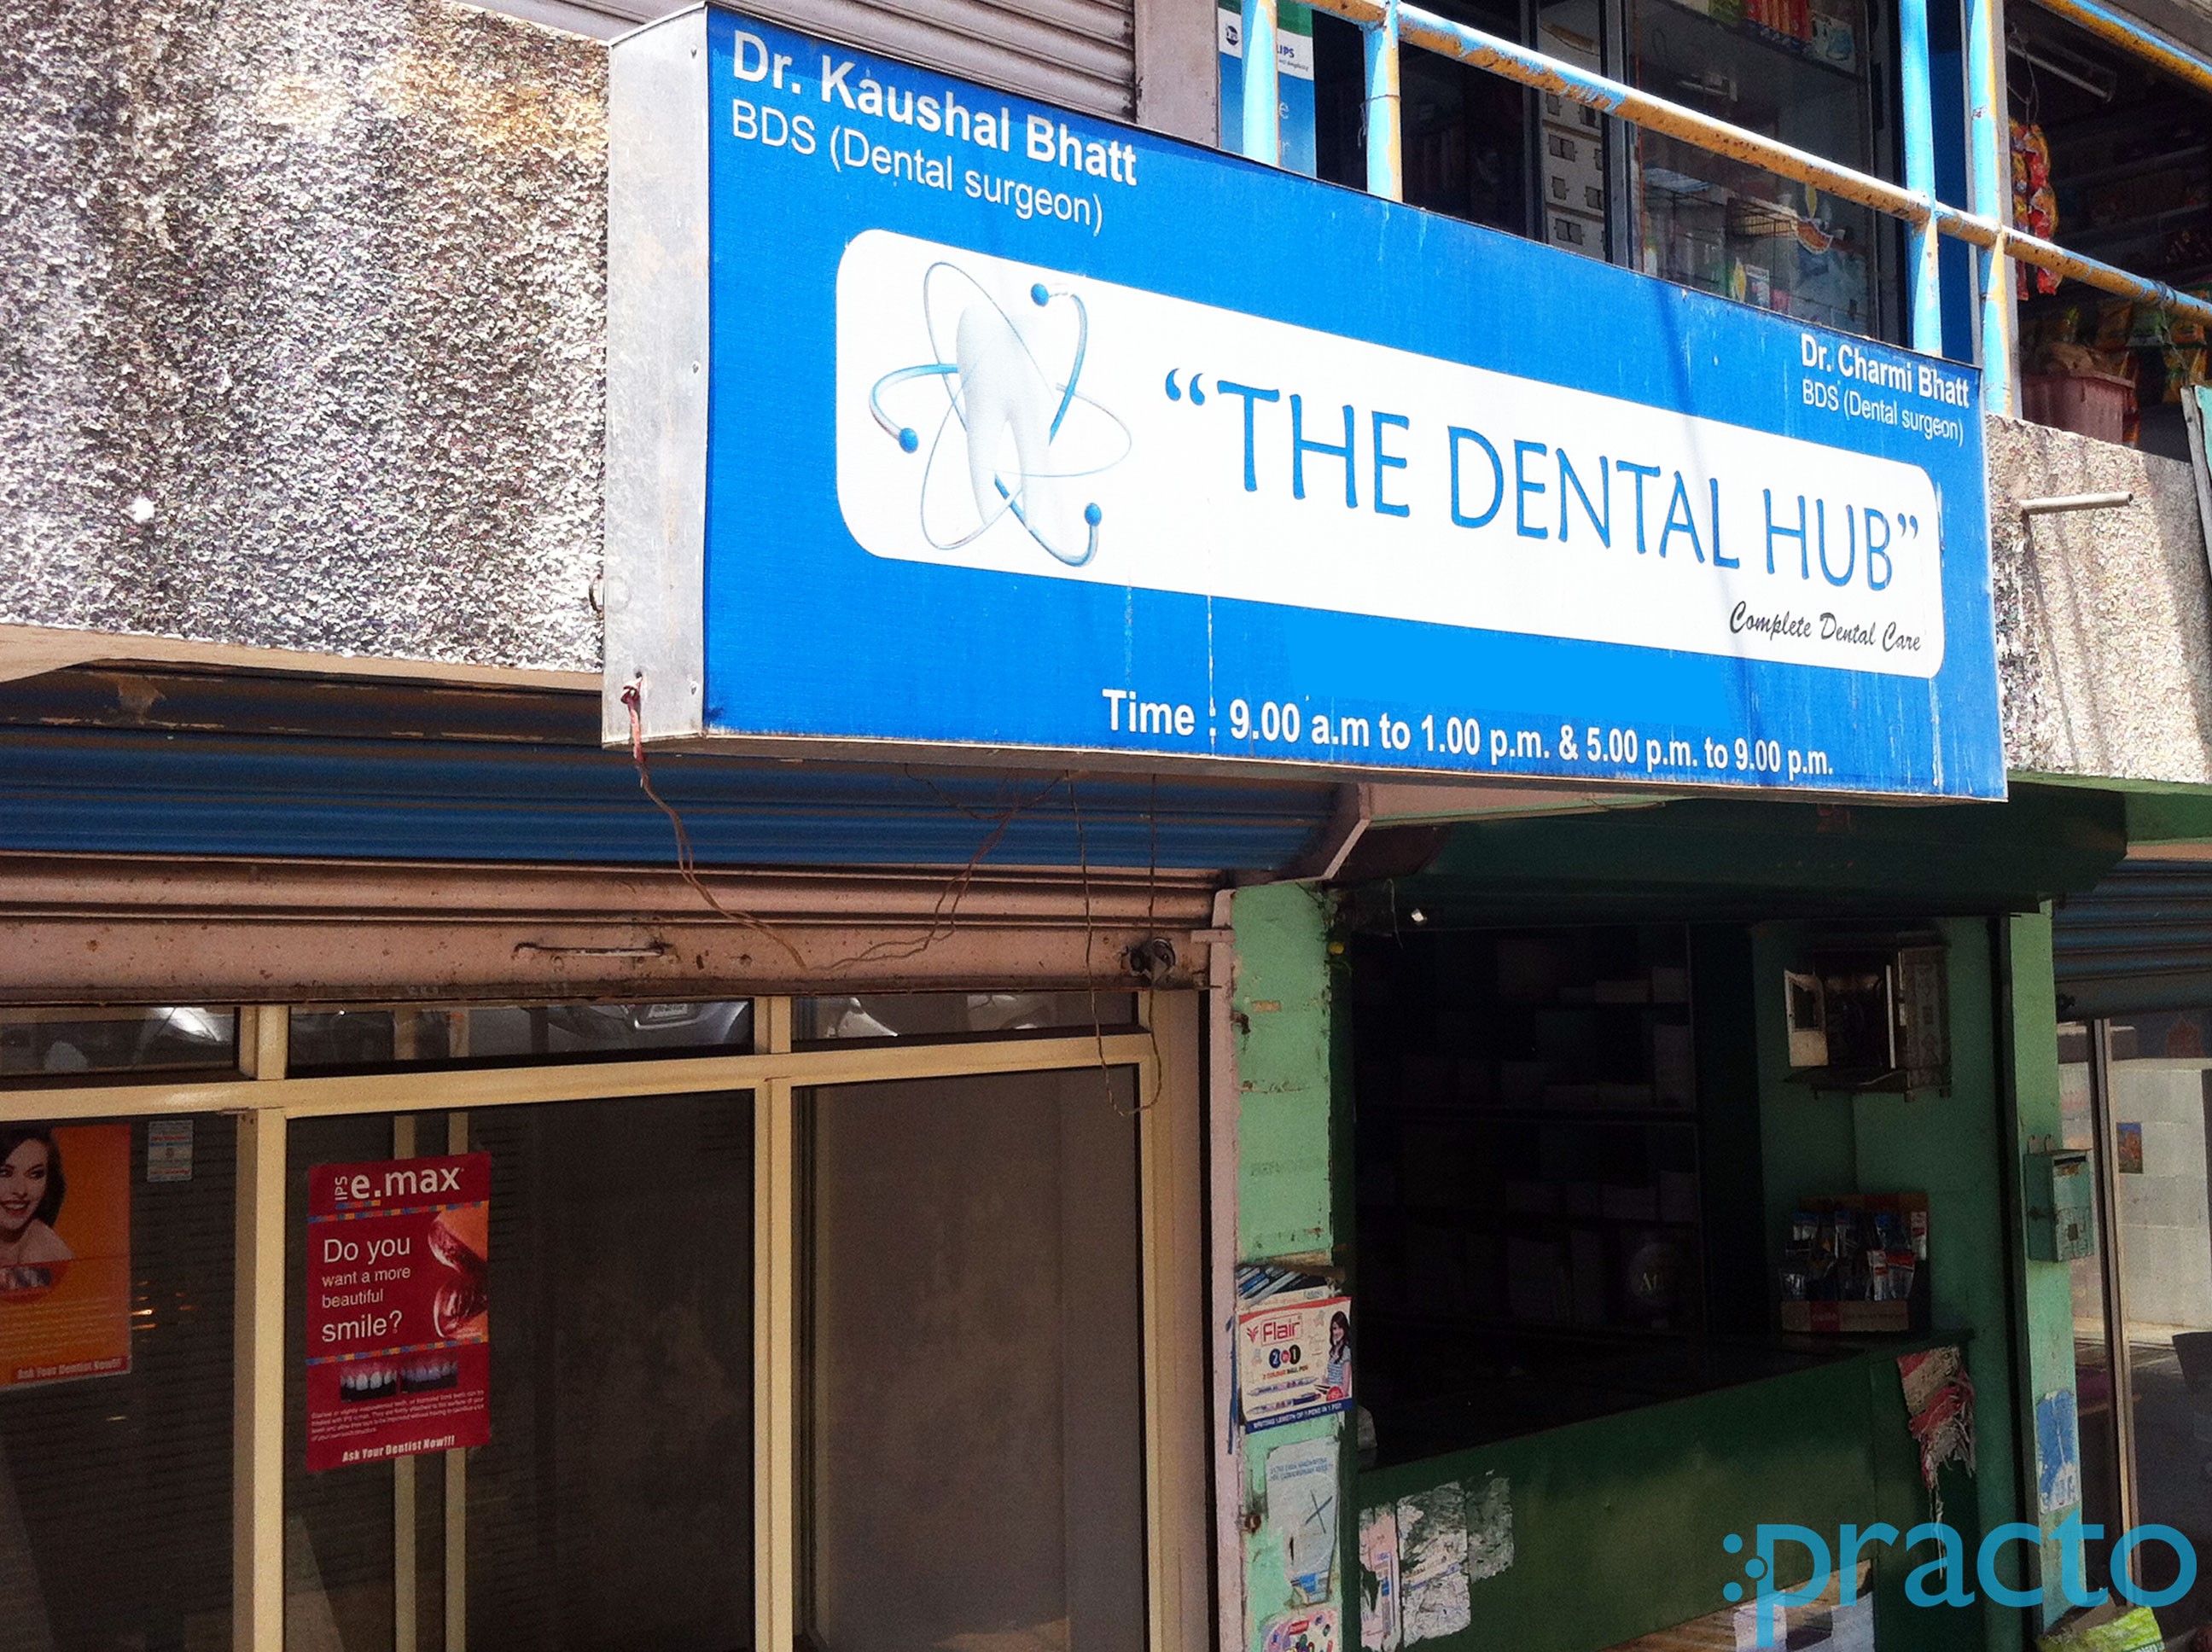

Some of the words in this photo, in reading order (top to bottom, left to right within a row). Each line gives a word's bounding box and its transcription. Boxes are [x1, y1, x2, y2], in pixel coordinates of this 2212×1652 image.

[733, 30, 801, 94] Dr.
[822, 55, 1010, 152] Kaushal
[1027, 114, 1138, 186] Bhatt
[732, 98, 816, 154] BDS
[830, 125, 952, 191] (Dental
[964, 170, 1103, 237] surgeon)
[1801, 333, 1831, 372] Dr.
[1838, 344, 1912, 393] Charmi
[1918, 365, 1970, 408] Bhatt
[1802, 379, 1839, 411] BDS
[1843, 389, 1898, 426] (Dental
[1901, 409, 1964, 447] surgeon)
[1164, 368, 1411, 518] “THE
[1447, 425, 1740, 570] DENTAL
[1762, 488, 1918, 591] HUB”
[1730, 601, 1811, 641] Complete
[1819, 612, 1877, 646] Dental
[1882, 621, 1922, 653] Care
[1102, 689, 1196, 736] Time
[1229, 699, 1301, 743] 9.00
[1312, 714, 1371, 747] a.m
[1379, 713, 1412, 751] to
[1421, 714, 1481, 756] 1.00
[1489, 727, 1550, 765] p.m.
[1558, 724, 1579, 761] &
[1586, 727, 1638, 764] 5.00
[1645, 738, 1698, 773] p.m.
[1704, 736, 1729, 771] to
[1735, 737, 1781, 773] 9.00
[1788, 747, 1834, 782] p.m.
[335, 1176, 347, 1201] IPS
[351, 1167, 460, 1200] e.max
[323, 1239, 359, 1263] Do
[367, 1237, 410, 1265] you
[322, 1288, 383, 1309] beautiful
[323, 1271, 358, 1288] want
[362, 1272, 371, 1283] a
[375, 1266, 410, 1282] more
[322, 1310, 403, 1342] smile?
[1263, 1318, 1300, 1342] Flair
[342, 1451, 359, 1463] Ask
[363, 1447, 383, 1459] Your
[386, 1440, 422, 1456] Dentist
